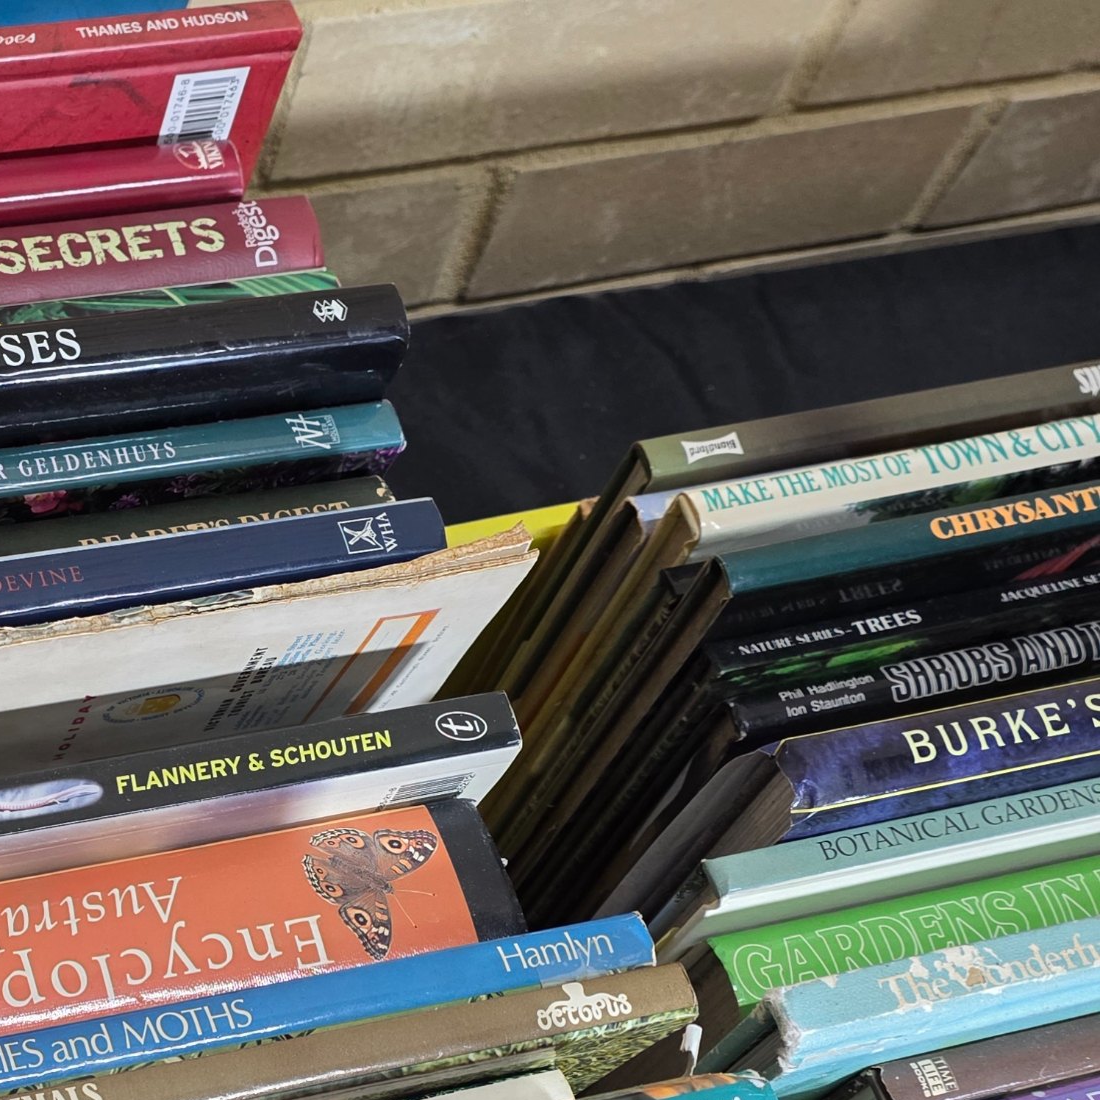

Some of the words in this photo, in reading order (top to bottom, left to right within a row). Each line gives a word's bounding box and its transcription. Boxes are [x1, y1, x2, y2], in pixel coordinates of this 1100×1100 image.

[76, 20, 142, 39] THAMES
[147, 18, 179, 32] AND
[181, 10, 249, 29] HUDSON
[232, 208, 257, 248] Reader's
[239, 200, 279, 267] Digest
[18, 441, 177, 478] GELDENHUYS
[701, 479, 774, 513] MAKE
[770, 468, 822, 497] THE
[824, 459, 881, 488] MOST
[881, 453, 912, 476] OF
[913, 432, 1009, 474] TOWN
[1007, 430, 1038, 458] &
[375, 512, 398, 553] WHA
[1001, 578, 1083, 602] JACQUELINE
[738, 635, 795, 656] NATURE
[881, 642, 1017, 702] SHRUBS
[1012, 627, 1087, 676] AND
[779, 687, 805, 701] Phil
[807, 673, 875, 696] Hadlington
[785, 704, 807, 717] Ion
[810, 692, 866, 713] Staunton
[52, 695, 97, 761] HOLIDAY
[115, 755, 241, 795] FLANNERY
[248, 753, 266, 771] &
[270, 730, 392, 768] SCHOUTEN
[817, 811, 980, 860] BOTANICAL
[980, 783, 1100, 826] GARDENS
[732, 890, 1028, 1000] GARDENS
[52, 1031, 113, 1063] and
[121, 999, 253, 1048] MOTHS
[497, 929, 615, 974] Hamlyn
[877, 971, 952, 1010] The
[909, 1062, 931, 1097] BOOKS
[921, 1063, 943, 1091] LIFE
[932, 1058, 956, 1090] TIME
